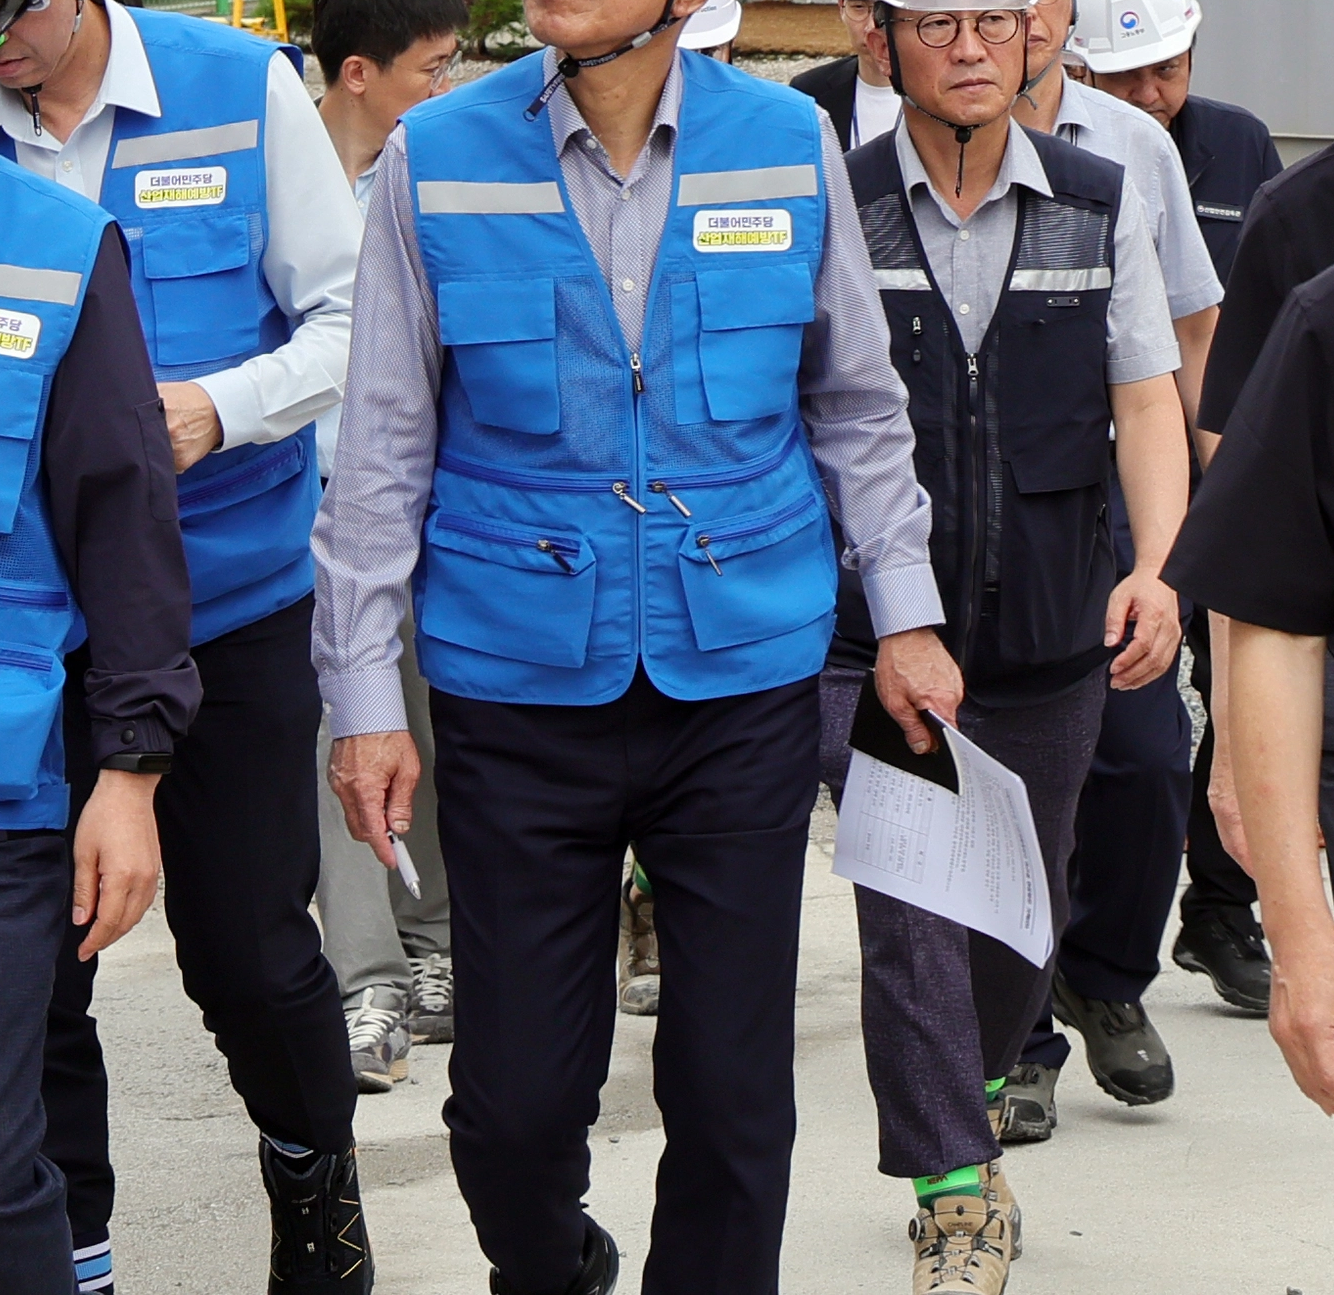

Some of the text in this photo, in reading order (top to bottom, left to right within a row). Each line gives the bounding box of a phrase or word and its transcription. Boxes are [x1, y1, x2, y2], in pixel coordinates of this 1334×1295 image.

[150, 173, 213, 187] 더불어민주당
[139, 185, 223, 203] 산업재해예방TF
[708, 216, 774, 229] 더불어민주당
[697, 230, 788, 246] 산업재해예방TF
